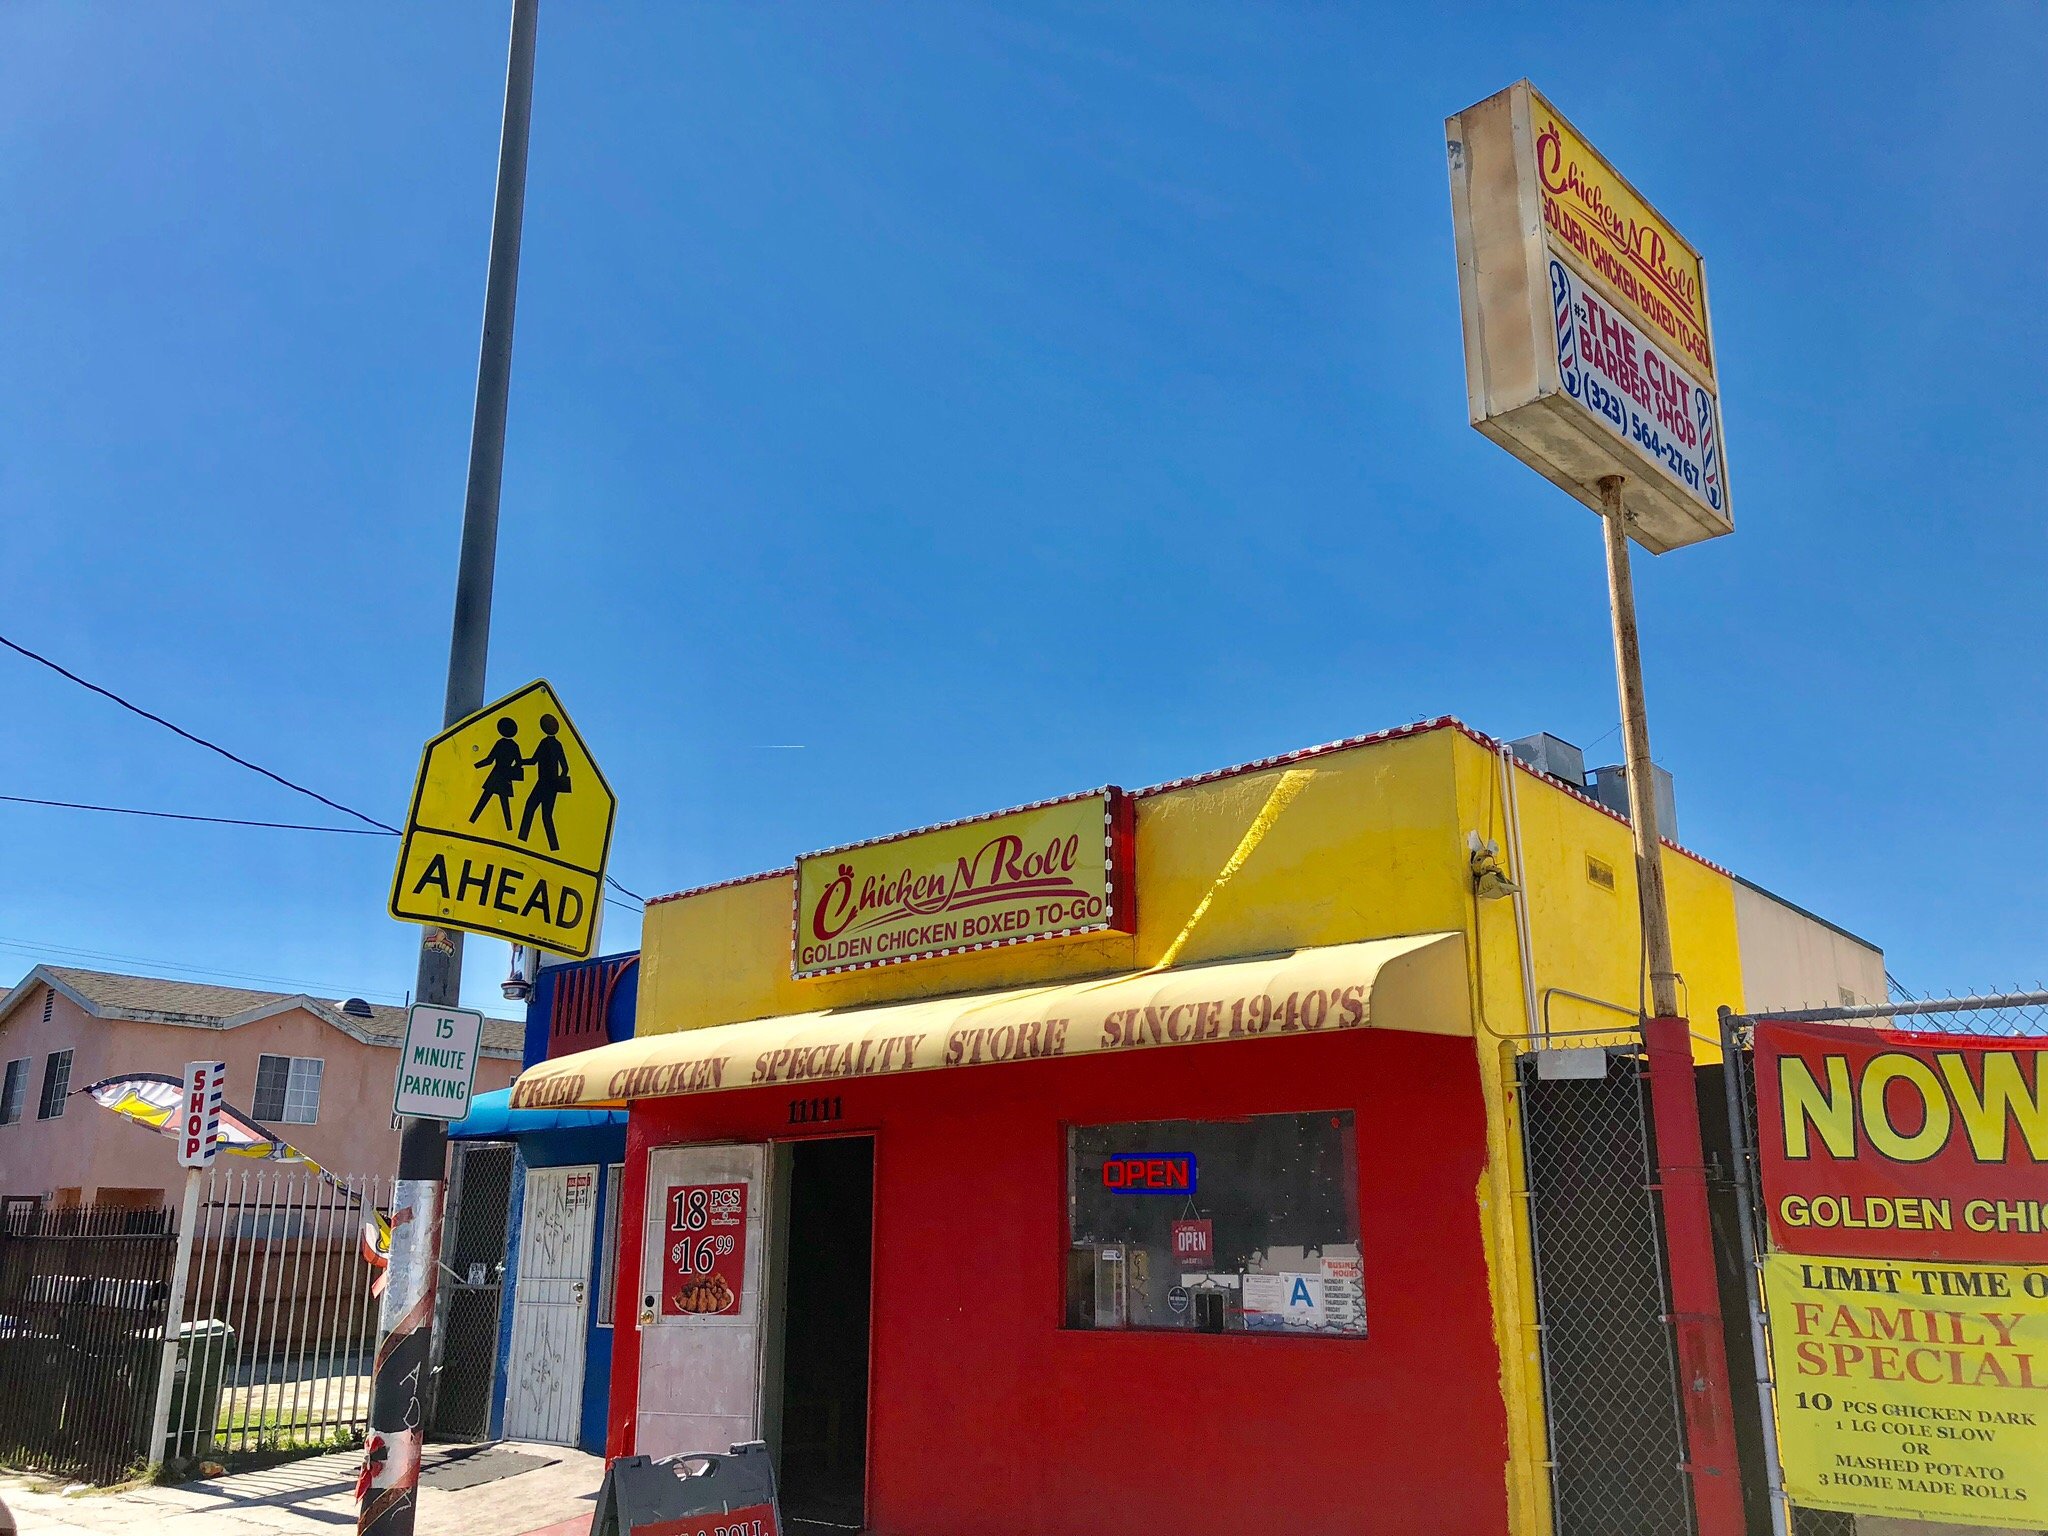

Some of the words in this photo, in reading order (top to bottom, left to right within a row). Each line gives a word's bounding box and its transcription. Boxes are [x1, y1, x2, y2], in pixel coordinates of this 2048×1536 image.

[1537, 122, 1625, 240] Chicken
[1645, 226, 1695, 305] Roll
[1590, 237, 1639, 306] CHICKEN
[1639, 282, 1676, 339] BOXED
[1675, 317, 1709, 369] TO-GO
[1573, 303, 1588, 324] #2
[1582, 292, 1639, 373] THE
[1644, 349, 1690, 418] CUT
[1579, 325, 1652, 415] BARBER
[1656, 391, 1697, 450] SHOP
[1584, 372, 1627, 437] (323)
[1631, 412, 1700, 491] 564-2767
[412, 854, 584, 930] AHEAD
[813, 864, 945, 942] Chicken
[978, 834, 1080, 885] Roll
[802, 936, 872, 965] GOLDEN
[877, 923, 958, 953] CHICKEN
[963, 909, 1031, 938] BOXED
[1035, 896, 1102, 926] TO-GO
[436, 1018, 454, 1039] 15
[510, 1073, 586, 1109] FRIED
[608, 1056, 730, 1099] CHICKEN
[751, 1034, 927, 1084] SPECIALTY
[945, 1018, 1070, 1066] STORE
[1100, 1000, 1223, 1049] SINCE
[1229, 984, 1366, 1037] 1940'S
[413, 1046, 466, 1070] MINUTE
[403, 1075, 466, 1100] PARKING
[185, 1070, 206, 1159] SHOP
[788, 1097, 843, 1124] 11111
[1777, 1051, 2048, 1164] NOW
[1103, 1160, 1189, 1188] OPEN
[671, 1189, 708, 1231] 18
[710, 1189, 740, 1206] PCS
[1780, 1194, 1953, 1231] GOLDEN
[1963, 1198, 2048, 1233] CHI
[1178, 1232, 1207, 1251] OPEN
[1327, 1261, 1360, 1269] BUSINE
[1332, 1269, 1358, 1277] HOURS
[1800, 1264, 1901, 1293] LIMIT
[1913, 1270, 2011, 1298] TIME
[1290, 1277, 1314, 1307] A
[1791, 1302, 2025, 1347] FAMILY
[1796, 1340, 2048, 1389] SPECIAL
[1795, 1391, 1833, 1411] 10
[1842, 1400, 1877, 1415] PCS
[1882, 1403, 1971, 1422] CHICKEN
[1977, 1410, 2037, 1426] DARK
[1836, 1420, 1843, 1430] 1
[1851, 1419, 1877, 1433] LG
[1882, 1421, 1932, 1438] COLE
[1937, 1426, 1996, 1442] SLOW
[1902, 1441, 1931, 1456] OR
[1836, 1454, 1920, 1473] MASHED
[1925, 1462, 2005, 1480] POTATO
[1819, 1473, 1829, 1486] 3
[1834, 1472, 1893, 1490] HOME
[1898, 1478, 1957, 1496] MADE
[1962, 1484, 2028, 1501] ROLLS
